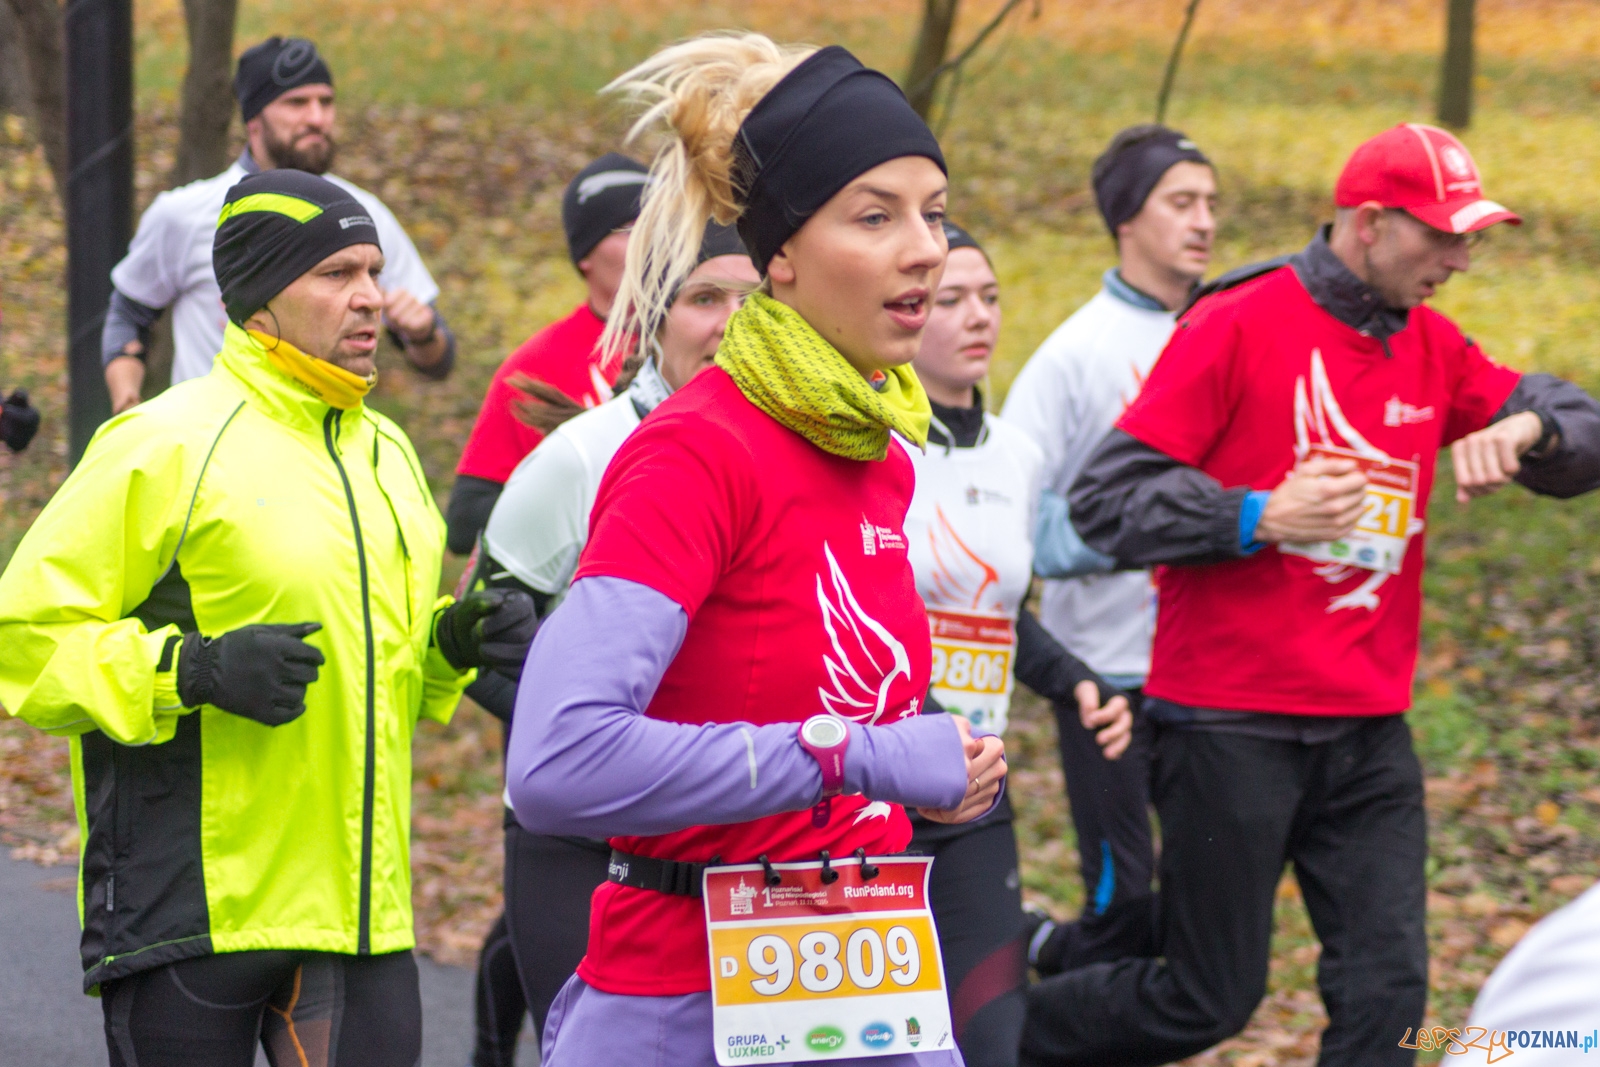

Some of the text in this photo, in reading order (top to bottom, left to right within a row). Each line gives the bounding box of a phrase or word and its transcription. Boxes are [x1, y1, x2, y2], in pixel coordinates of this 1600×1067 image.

[931, 647, 1005, 691] 9806
[761, 886, 773, 907] 1
[843, 882, 914, 898] RunPoland.org
[719, 925, 921, 996] D 9809
[727, 1033, 767, 1047] GRUPA
[811, 1035, 842, 1048] energy
[727, 1045, 775, 1059] LUXMED
